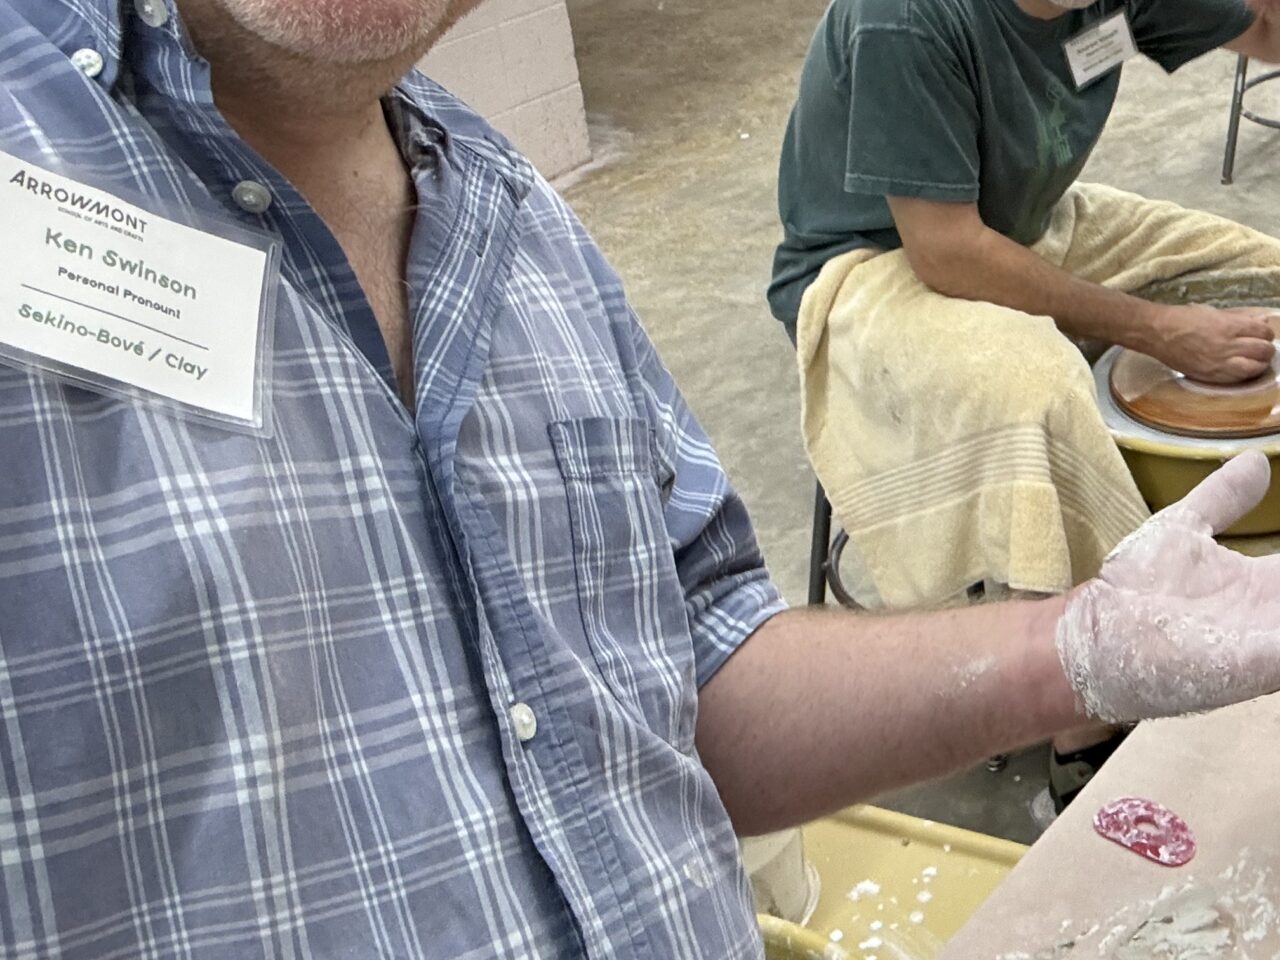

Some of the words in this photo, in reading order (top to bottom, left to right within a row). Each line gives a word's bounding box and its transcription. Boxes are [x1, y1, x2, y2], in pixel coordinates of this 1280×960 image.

[9, 169, 147, 234] ARROWMONT
[45, 227, 93, 260] Ken
[102, 249, 197, 300] Swinson
[57, 266, 120, 296] Personal
[18, 303, 145, 356] Sekino-Bové
[147, 347, 163, 362] /
[165, 353, 208, 381] Clay
